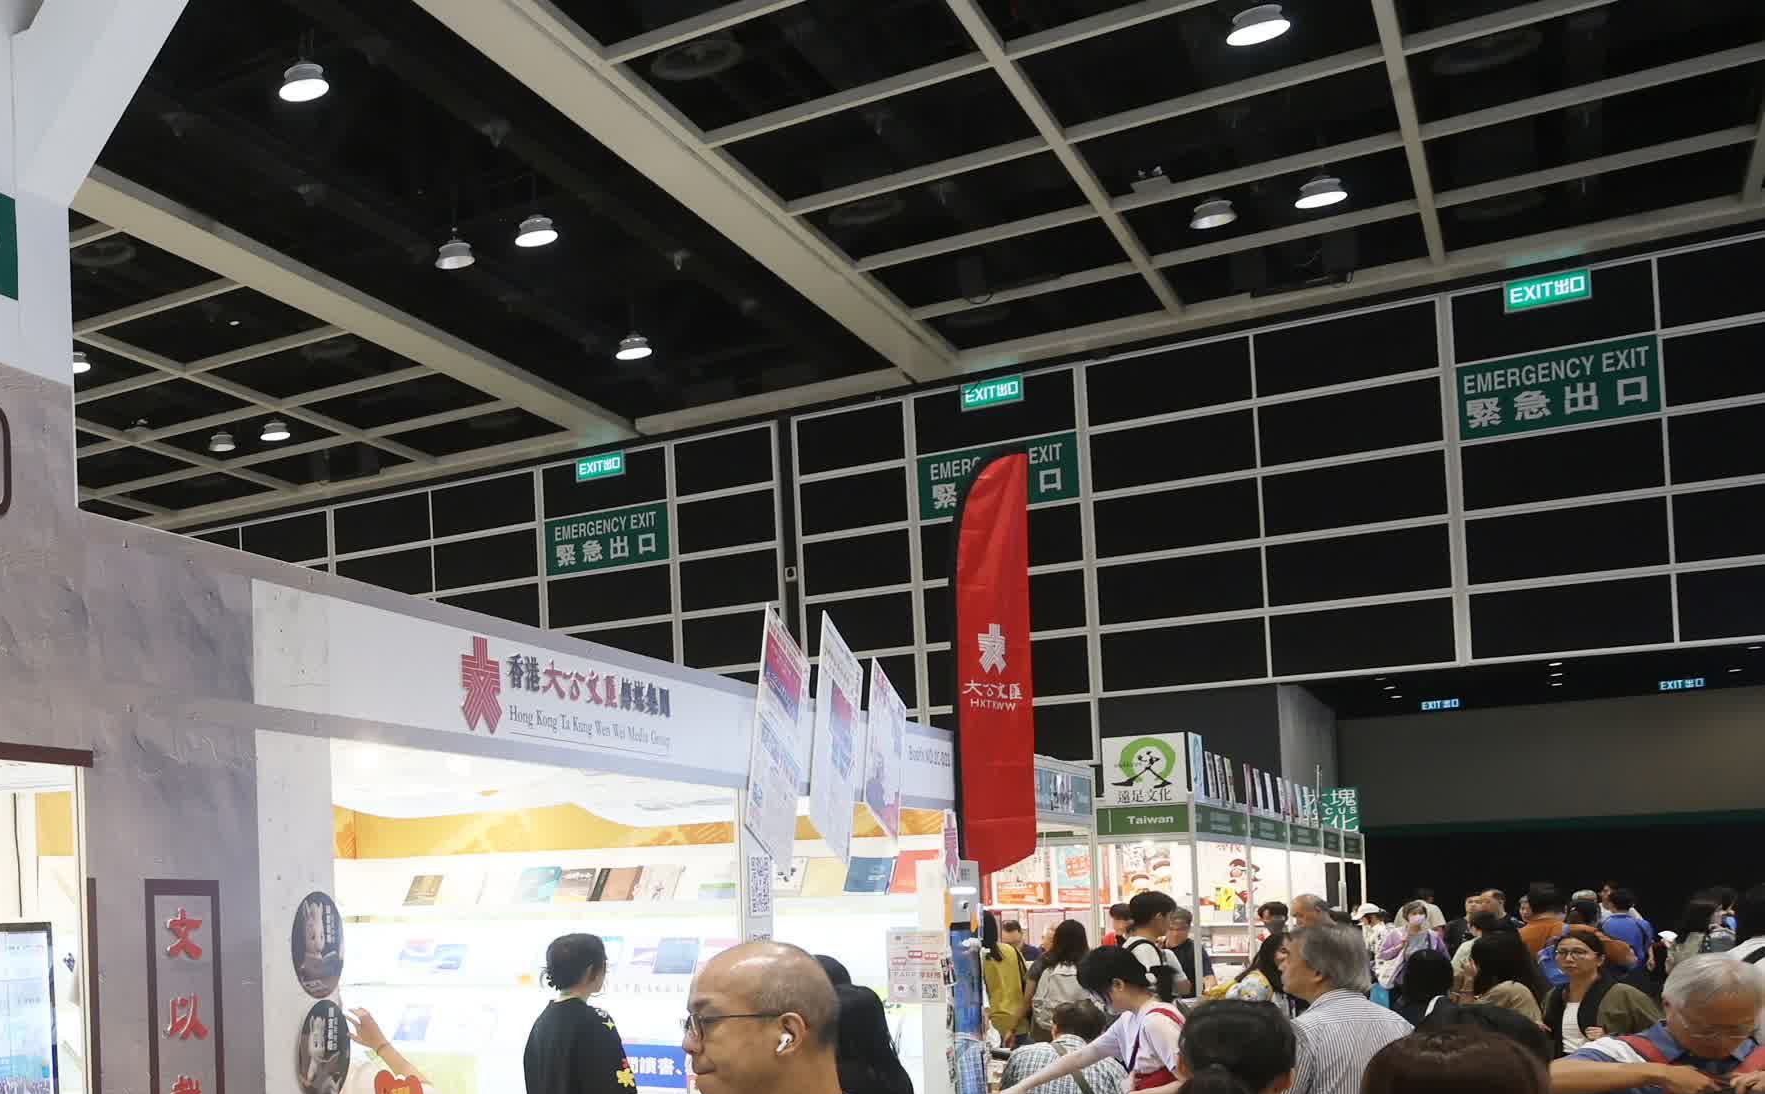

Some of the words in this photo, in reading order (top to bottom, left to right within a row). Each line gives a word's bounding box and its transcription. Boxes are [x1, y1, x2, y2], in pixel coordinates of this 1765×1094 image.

[1463, 354, 1595, 396] EMERGENCY
[1601, 345, 1650, 374] EXIT
[1465, 375, 1649, 430] 緊急出口
[1028, 442, 1063, 465] EXIT
[554, 515, 628, 542] EMERGENCY
[630, 511, 657, 530] EXIT
[555, 532, 657, 567] 緊急出口
[962, 679, 1023, 700] 大公文匯
[509, 704, 534, 729] Hong
[536, 710, 558, 734] Kong
[1117, 788, 1173, 804] 遠足文化
[1127, 814, 1175, 826] Taiwan
